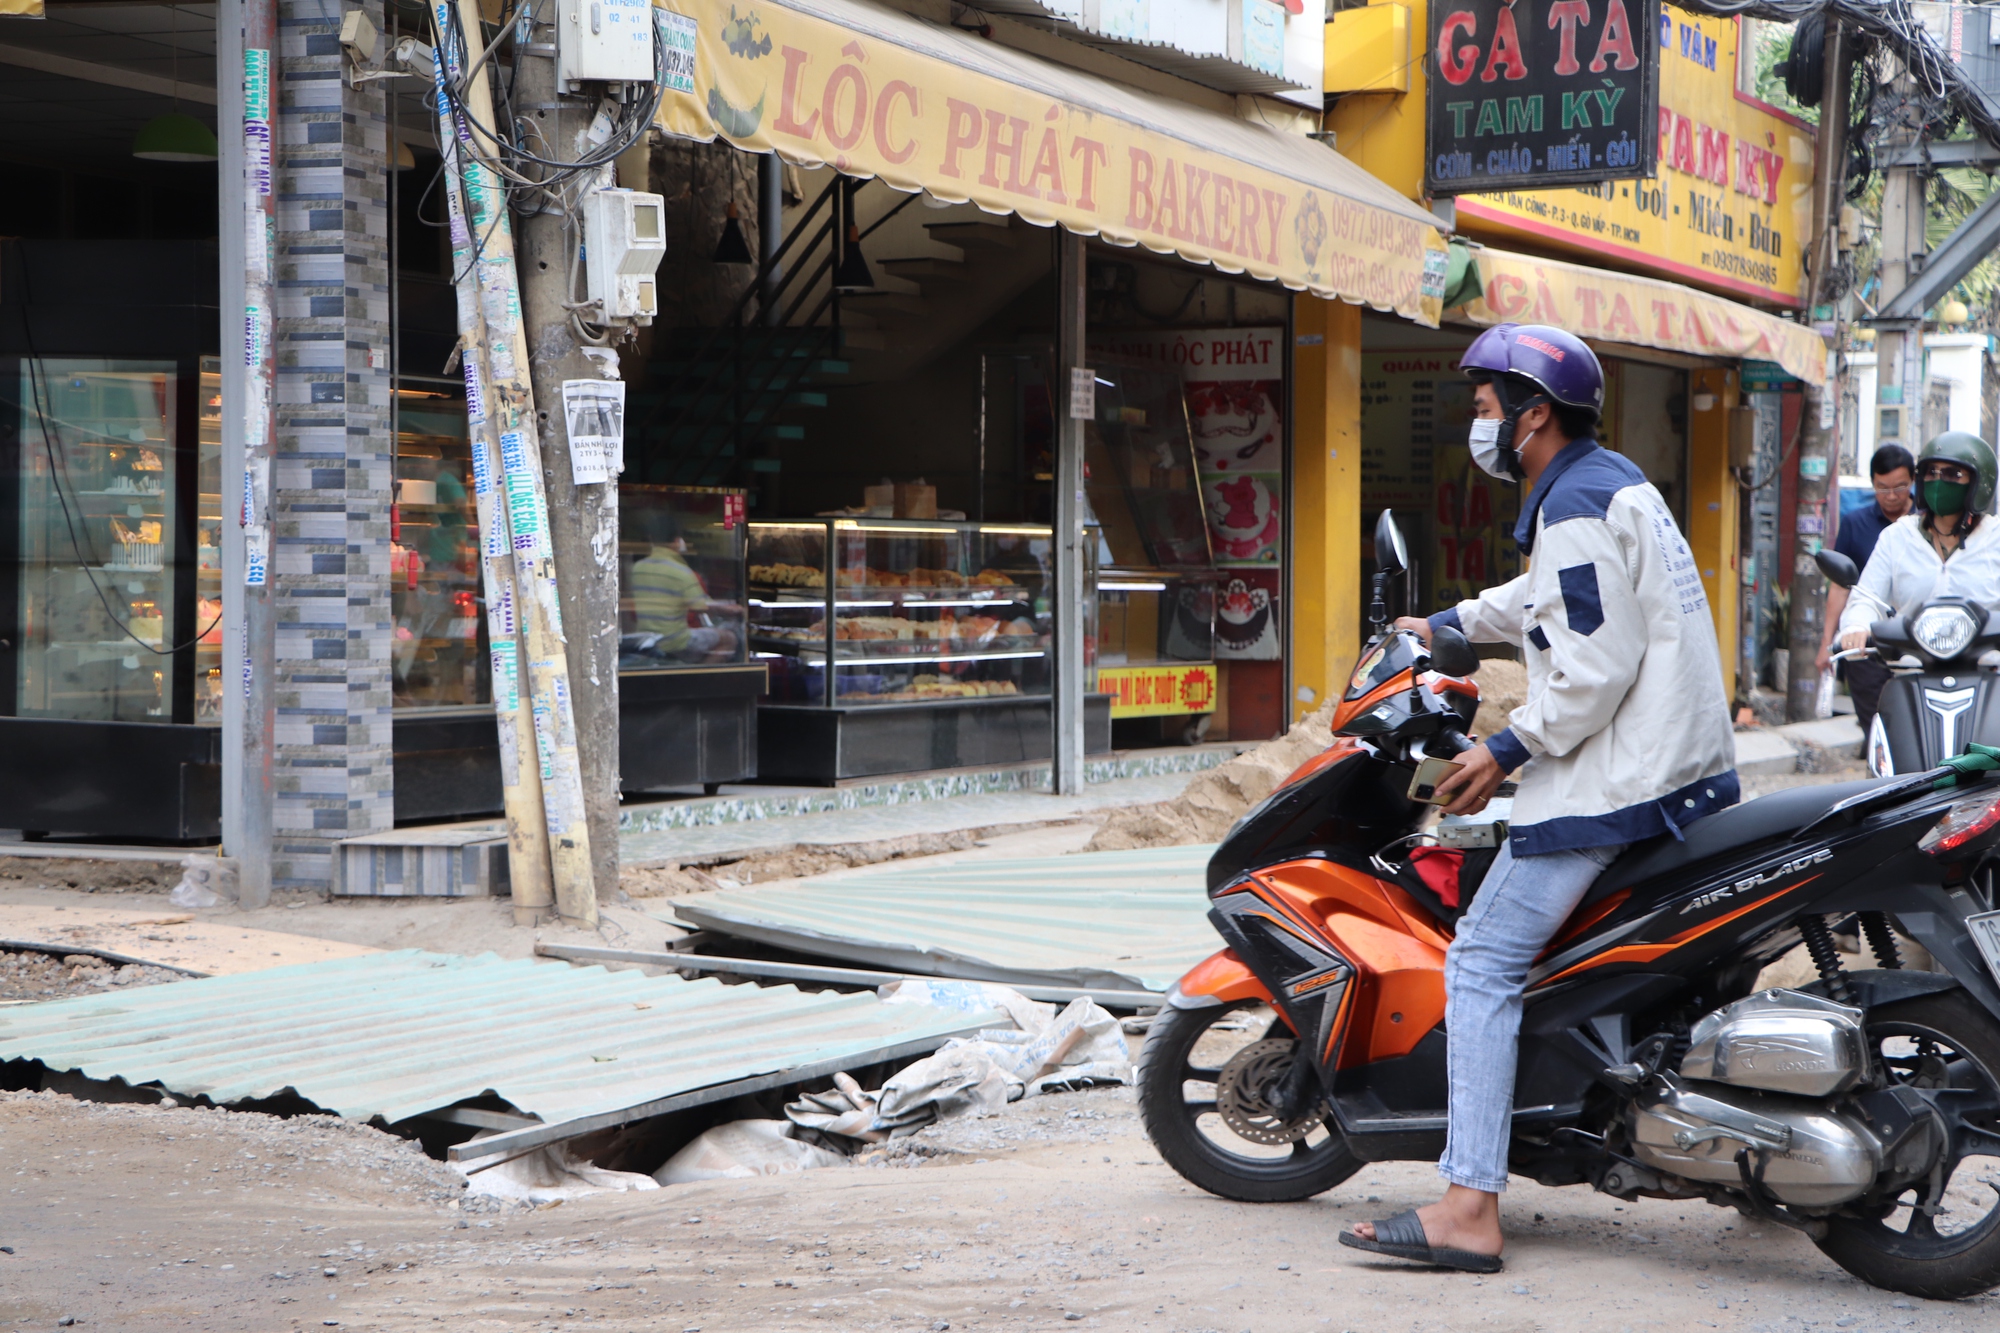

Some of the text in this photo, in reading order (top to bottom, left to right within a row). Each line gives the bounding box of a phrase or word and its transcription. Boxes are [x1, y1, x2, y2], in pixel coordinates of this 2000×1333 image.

[609, 13, 640, 23] 02 41
[632, 33, 648, 42] 183
[1547, 0, 1640, 76] TA
[1679, 22, 1718, 72] VÂN
[1446, 78, 1626, 138] TAM KỲ
[773, 40, 1288, 266] LỘC PHÁT BAKERY
[1487, 142, 1532, 176] CHÁO
[1547, 133, 1591, 172] MIẾN
[1606, 131, 1637, 167] GỎI
[1734, 130, 1784, 205] KỲ
[1332, 198, 1422, 261] 0977.919.398
[1525, 195, 1547, 216] CÔNG
[1580, 211, 1591, 229] GÒ
[1688, 190, 1734, 243] Miến
[1750, 211, 1782, 258] Bún
[1713, 249, 1777, 285] 0937830985
[1486, 267, 1563, 325] GÀ
[1575, 286, 1640, 335] TA
[1211, 332, 1273, 366] PHÁT
[1382, 358, 1441, 373] QUÁN
[1515, 334, 1566, 362] YAMAHA
[574, 439, 590, 449] BÁN
[1680, 848, 1834, 915] AIR BLADE
[1294, 970, 1339, 995] 125
[1776, 1059, 1827, 1073] HONDA
[1771, 1150, 1824, 1167] HONDA
